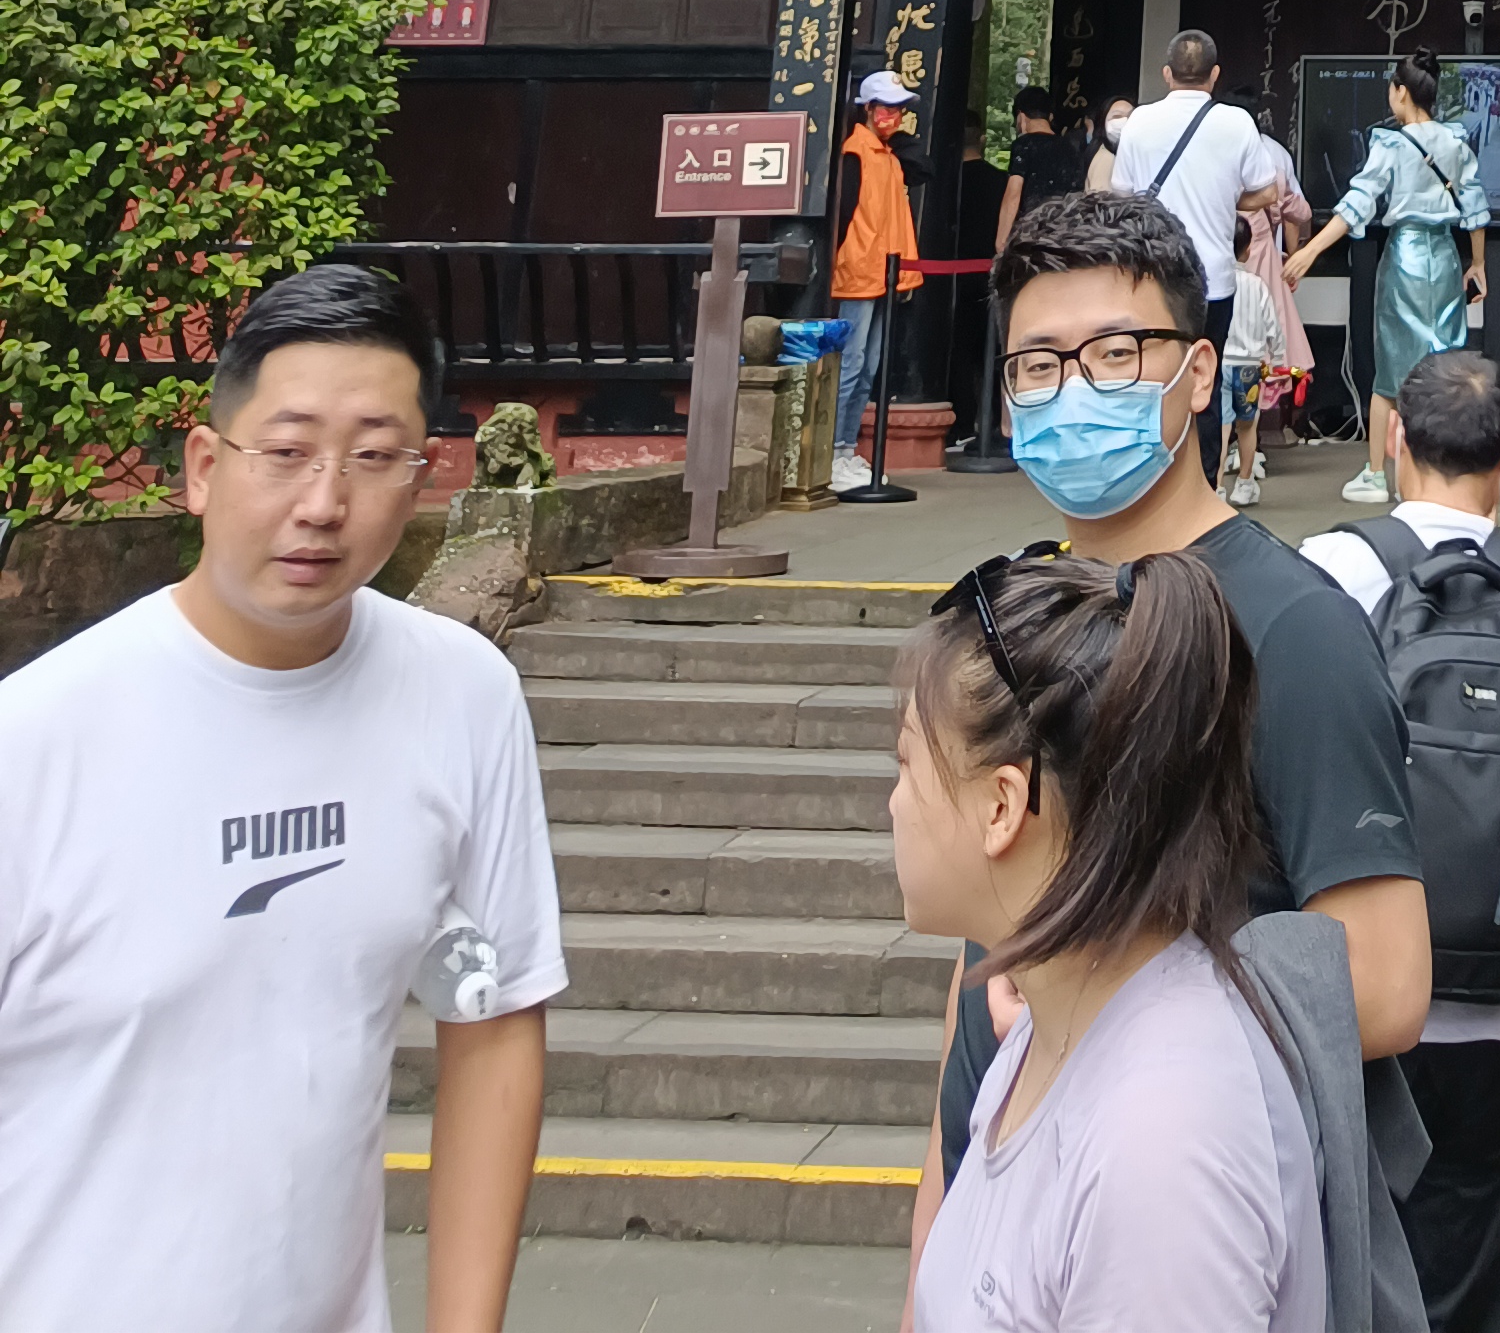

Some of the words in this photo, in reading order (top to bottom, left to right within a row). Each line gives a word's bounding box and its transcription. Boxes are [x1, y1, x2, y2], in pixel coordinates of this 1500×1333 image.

[678, 149, 732, 169] 入口
[675, 171, 732, 183] Entrance
[221, 801, 346, 865] PUMA
